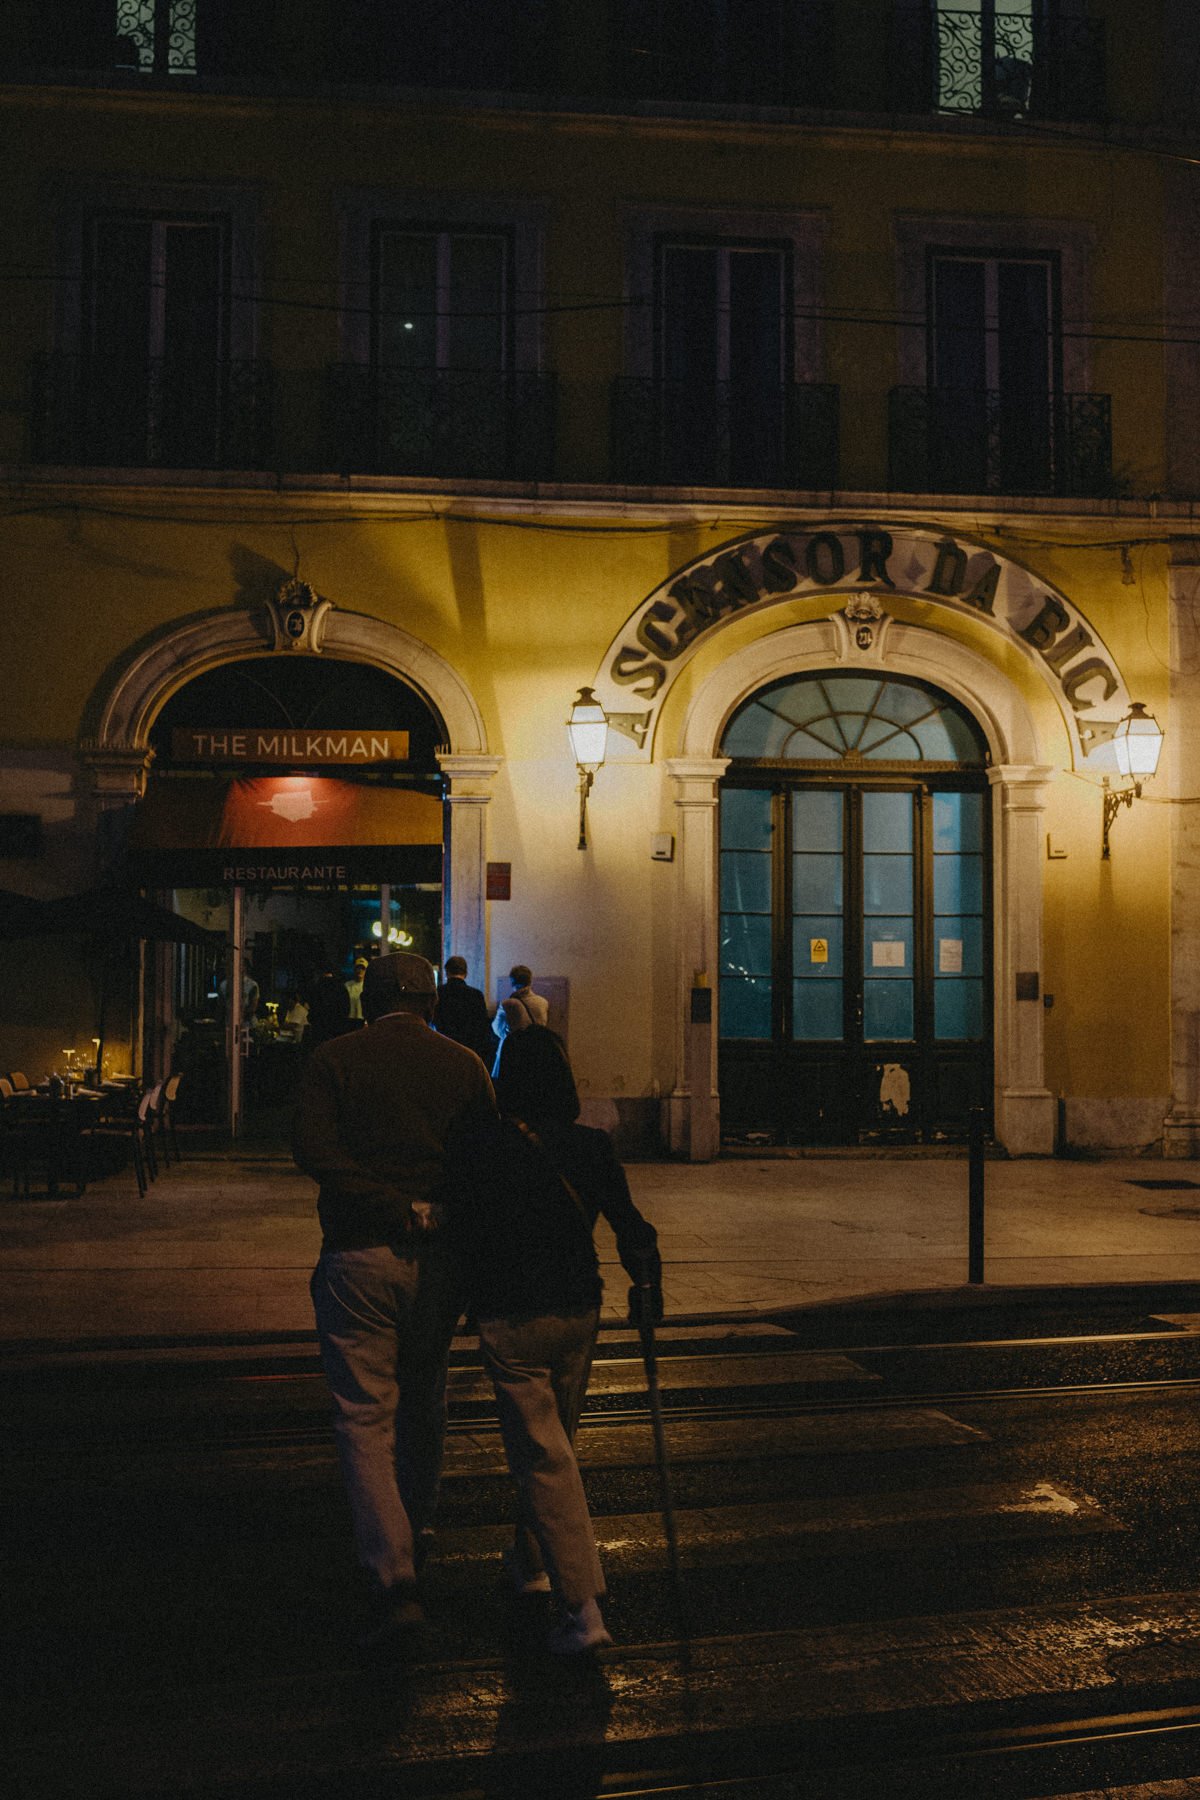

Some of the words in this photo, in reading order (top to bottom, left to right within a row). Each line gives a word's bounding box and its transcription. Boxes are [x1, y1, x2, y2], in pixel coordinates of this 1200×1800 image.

[604, 527, 895, 750] ASCENSOR
[924, 536, 1002, 618] DA
[1014, 594, 1119, 758] BICA
[191, 734, 248, 757] THE
[256, 735, 390, 758] MILKMAN
[223, 865, 347, 881] RESTAURANTE
